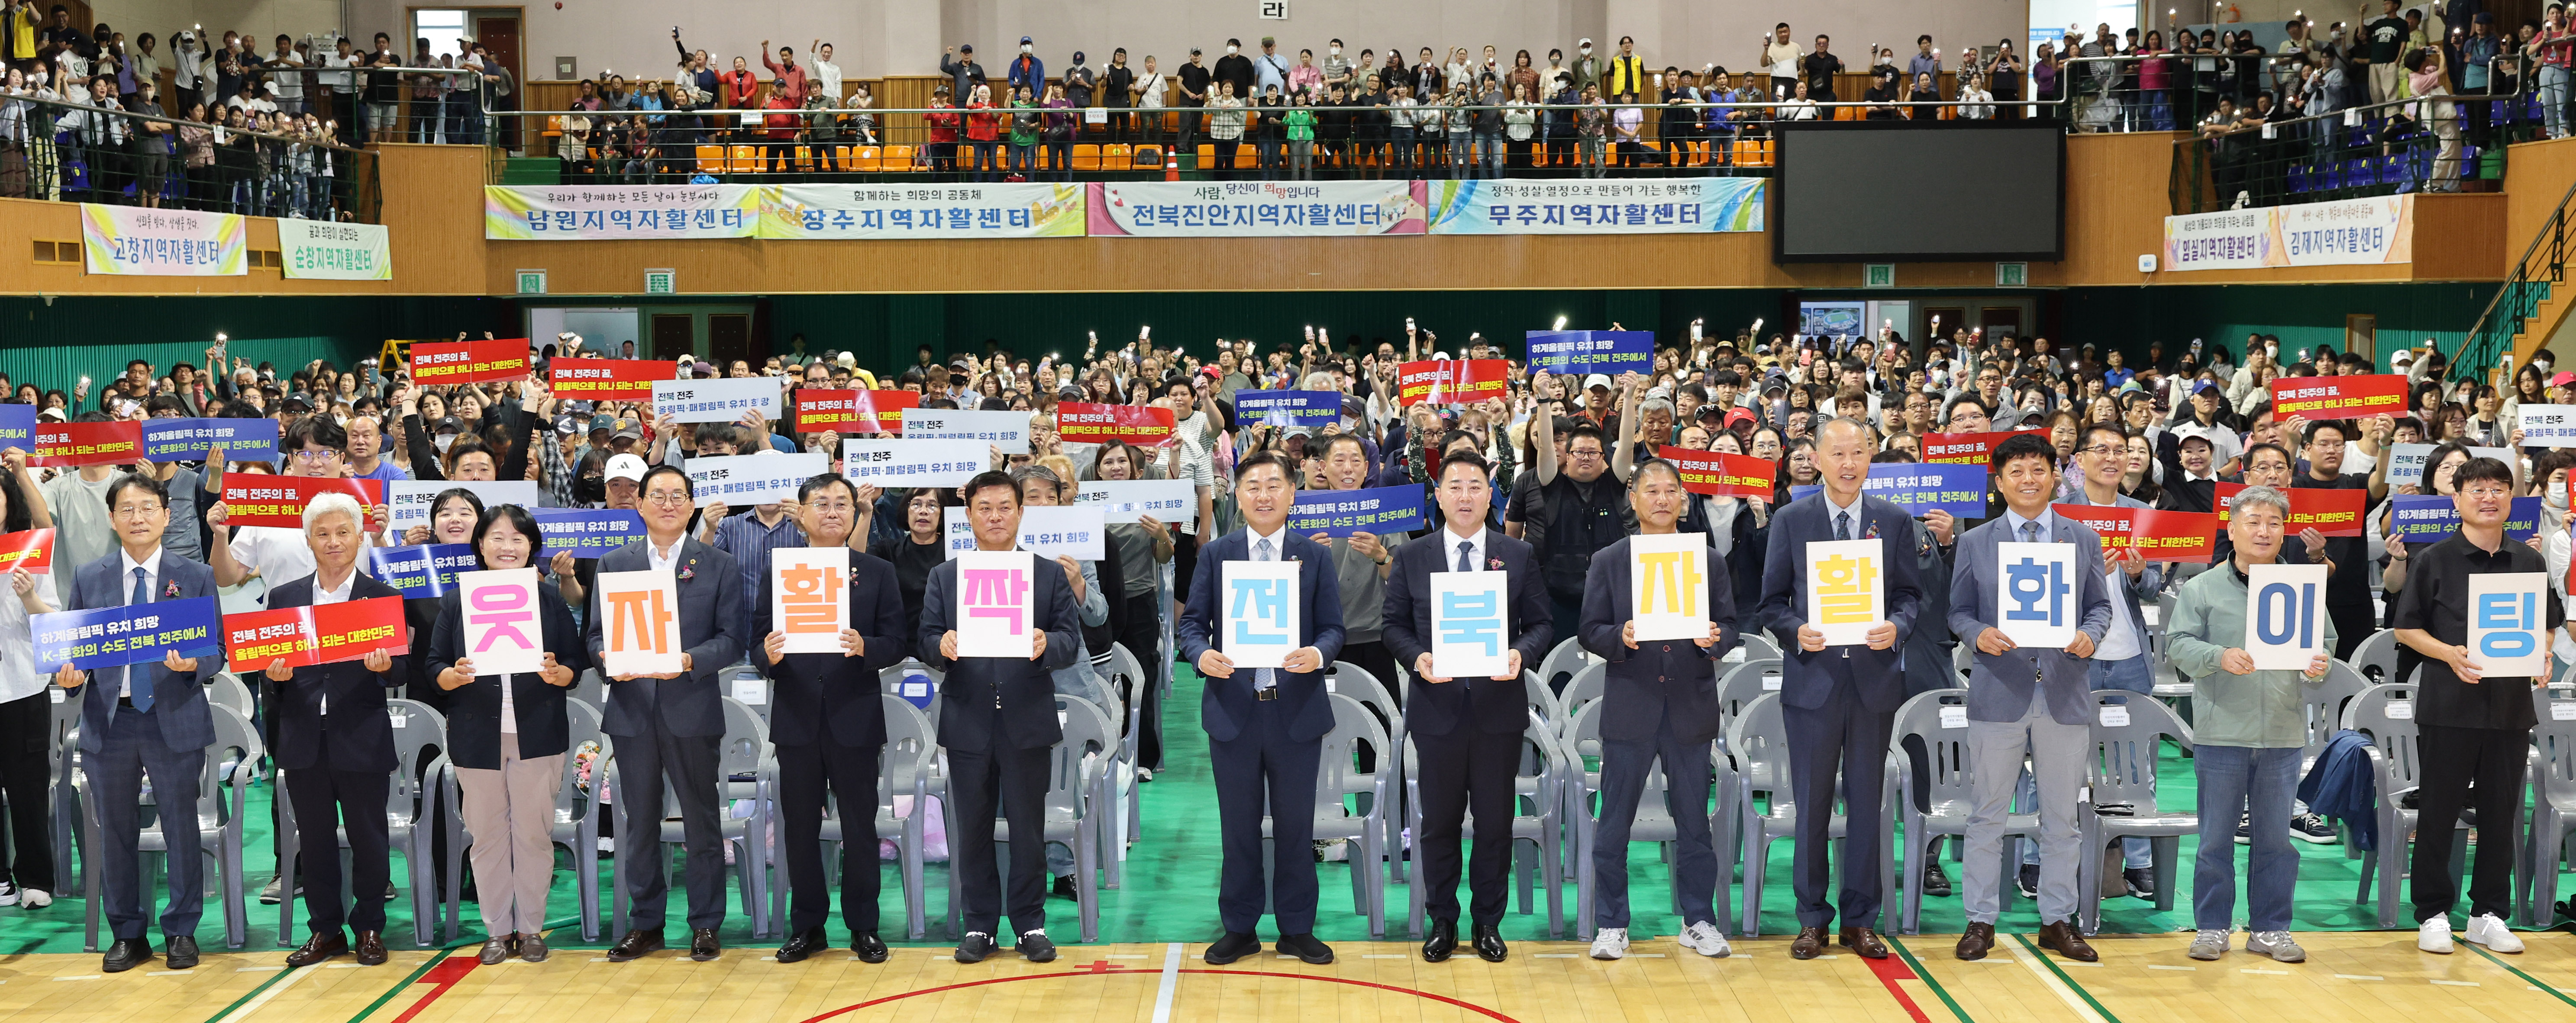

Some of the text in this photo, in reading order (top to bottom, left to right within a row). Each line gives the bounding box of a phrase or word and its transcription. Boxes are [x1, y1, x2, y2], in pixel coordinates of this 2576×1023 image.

[1264, 2, 1284, 17] 라
[548, 191, 720, 203] 우리가 함께하는 모든 날이 눈부시다
[853, 190, 981, 201] 함께하는 희망의 공동체
[1194, 183, 1320, 201] 사람, 당신이 희망입니다
[1598, 185, 1634, 197] 만들어
[1638, 184, 1661, 196] 가는
[1666, 184, 1702, 195] 행복한
[136, 214, 199, 230] 신뢰를 빚다, 상생을 짓다.
[526, 208, 743, 231] 남원지역자활센터
[802, 208, 1030, 230] 장수지역자활센터
[1133, 203, 1381, 227] 전북진안지역자활센터
[1489, 203, 1701, 226] 무주지역자활센터
[309, 225, 358, 241] 꿈과 희망이 실현되는
[2291, 227, 2382, 255] 김제지역자활센터
[114, 237, 220, 265] 고창지역자활센터
[2183, 236, 2255, 261] 임실지역자활센터
[296, 245, 372, 271] 순창지역자활센터
[1532, 340, 1614, 354] 하계올림픽 유치 희망
[415, 352, 470, 365] 전북 전주의 꿈,
[1532, 352, 1647, 367] K-문화의 수도 전북 전주에서
[415, 358, 523, 377] 올림픽으로 하나 되는 대한민국
[555, 368, 613, 379] 전북 전주의 꿈,
[555, 381, 633, 391] 올림픽으로 하나 되는
[1402, 375, 1416, 384] 전북
[1417, 372, 1440, 383] 전주의
[658, 390, 694, 401] 전북 전주
[1402, 380, 1503, 397] 올림픽으로 하나 되는 대한민국
[2277, 386, 2340, 400] 전북 전주의 꿈,
[730, 399, 747, 409] 유치
[751, 397, 769, 407] 희망
[1240, 397, 1307, 409] 하계올림픽 유치 희망
[2278, 394, 2400, 413] 올림픽으로 하나 되는 대한민국
[1061, 413, 1116, 424] 전북 전주의 꿈,
[1240, 407, 1336, 419] K-문화의 수도 전북 전주에서
[148, 427, 234, 442] 하계올림픽 유치 희망
[1061, 425, 1168, 436] 올림픽으로 하나 되는 대한민국
[148, 439, 271, 455] K-문화의 수도 전북 전주에서
[850, 451, 891, 462] 전북 전주
[931, 463, 952, 473] 유치
[956, 461, 976, 472] 희망
[1682, 460, 1720, 471] 전주의 꿈,
[1706, 474, 1769, 489] 하나 되는 대한민국
[1288, 499, 1379, 515] 하계올림픽 유치 희망
[2398, 509, 2448, 520] 하계올림픽
[1288, 508, 1416, 531] K-문화의 수도 전북 전주에서
[2083, 520, 2131, 532] 전주의 꿈,
[2397, 523, 2440, 534] K-문화의
[2112, 536, 2205, 548] 하나 되는 대한민국
[1639, 551, 1701, 617] 자
[1815, 554, 1877, 624] 활
[2006, 557, 2069, 627] 화
[781, 563, 843, 634] 활
[964, 569, 1029, 635] 짝
[471, 584, 535, 653] 웃
[1230, 578, 1288, 645] 전
[2257, 582, 2315, 649] 이
[41, 616, 159, 644] 하계올림픽 유치 희망
[607, 590, 672, 654] 자
[1439, 590, 1501, 656] 북
[2478, 592, 2535, 658] 팅
[232, 622, 314, 644] 전북 전주의 꿈,
[42, 626, 207, 664] K-문화의 수도 전북 전주에서
[235, 625, 395, 661] 올림픽으로 하나 되는 대한민국
